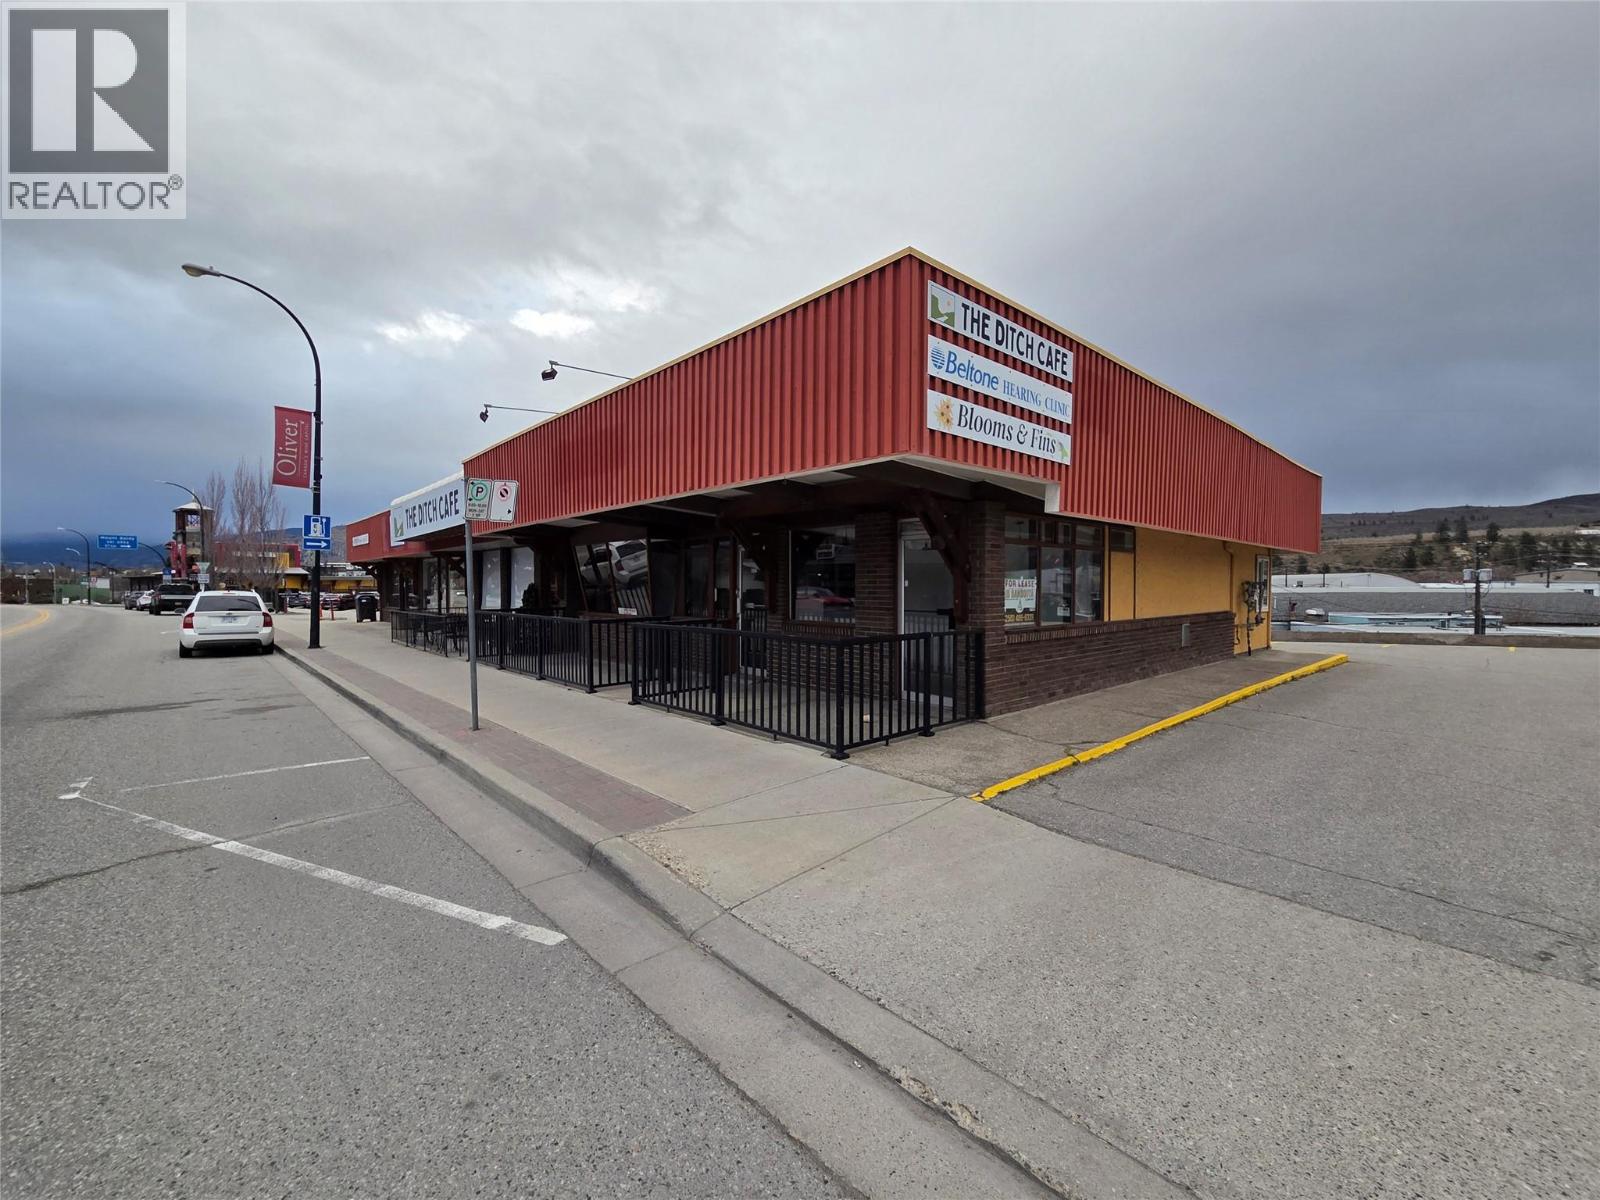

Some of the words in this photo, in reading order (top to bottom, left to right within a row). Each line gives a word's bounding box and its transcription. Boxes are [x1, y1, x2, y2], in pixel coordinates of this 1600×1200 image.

[961, 302, 991, 342] THE
[995, 320, 1034, 361] DITCH
[1037, 341, 1068, 377] CAFE
[945, 351, 999, 391] Beltone
[1003, 379, 1041, 407] HEARING
[1044, 397, 1070, 418] CLINIC
[275, 418, 298, 476] Oliver
[957, 404, 1013, 442] Blooms
[1016, 424, 1028, 445] &
[1031, 427, 1057, 455] Fins
[405, 506, 417, 529] THE
[418, 498, 438, 525] DITCH
[438, 489, 460, 520] CAFE
[1005, 579, 1017, 588] FOR
[1018, 579, 1035, 588] LEASE
